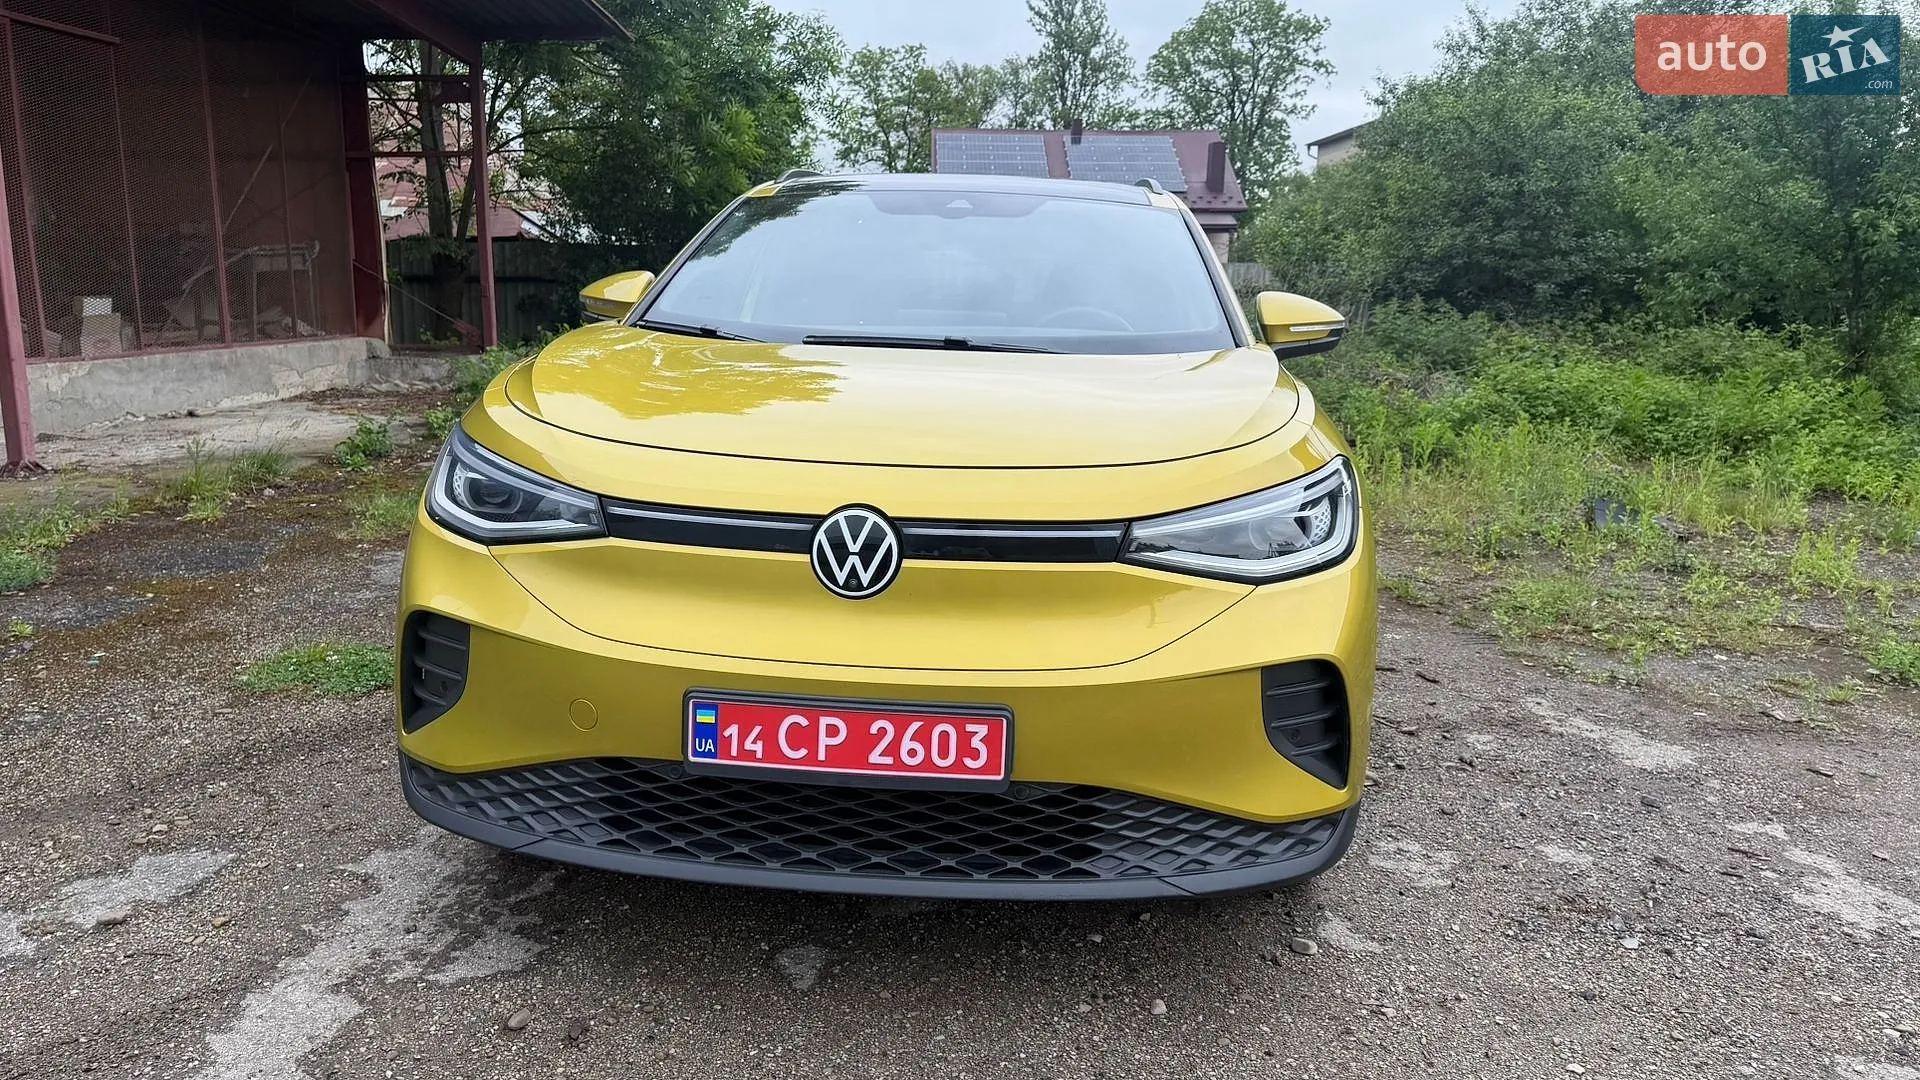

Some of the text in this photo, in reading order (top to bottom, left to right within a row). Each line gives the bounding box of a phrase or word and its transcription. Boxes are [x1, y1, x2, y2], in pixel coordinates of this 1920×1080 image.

[695, 738, 715, 753] UA
[722, 714, 989, 769] 14 CP 2603
